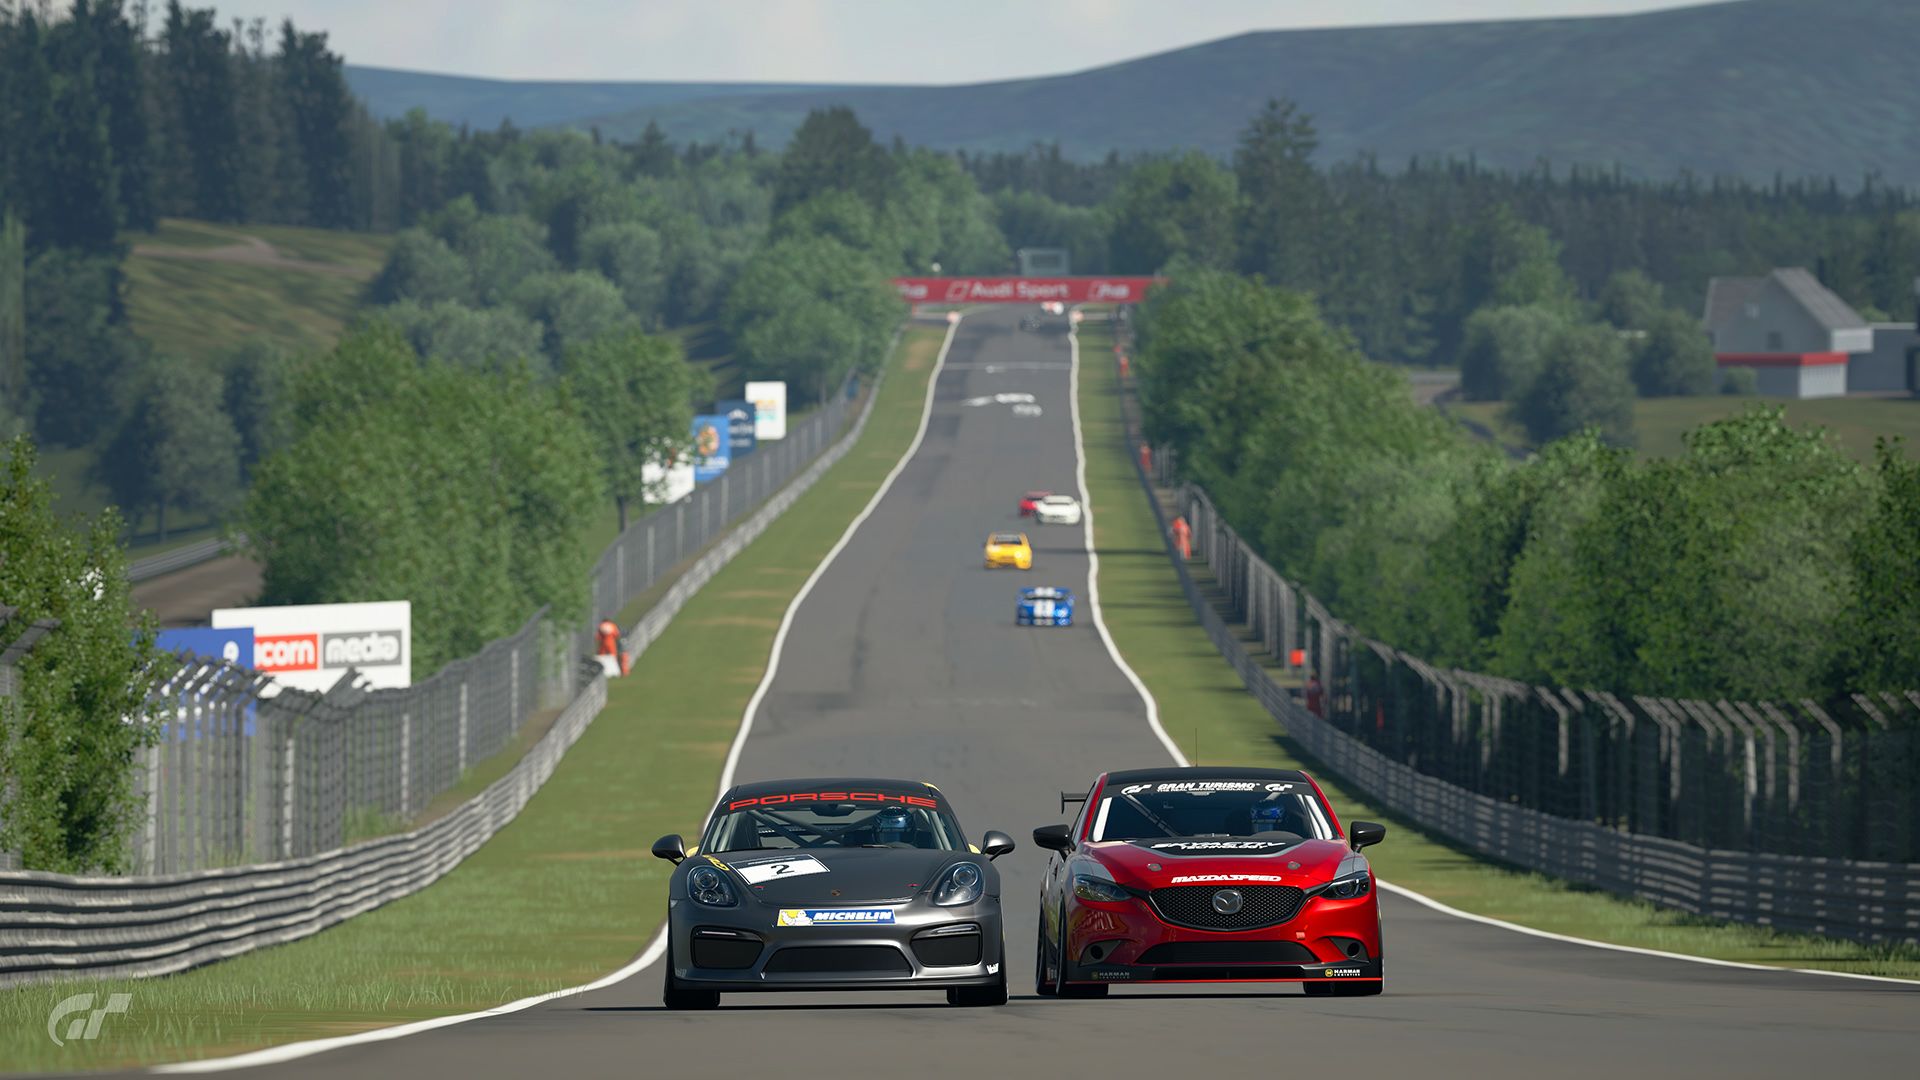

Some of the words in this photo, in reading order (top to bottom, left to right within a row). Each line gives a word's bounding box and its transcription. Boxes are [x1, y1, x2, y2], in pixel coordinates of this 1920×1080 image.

[971, 281, 1012, 297] Audi
[1016, 281, 1069, 299] Sport
[325, 633, 399, 664] media
[1157, 782, 1196, 791] GRAN
[1198, 782, 1256, 791] TURISMO
[729, 792, 937, 811] PORSCHE
[770, 863, 795, 875] 2
[1171, 874, 1282, 884] MAZDASPEED
[813, 911, 892, 921] MICHELIN
